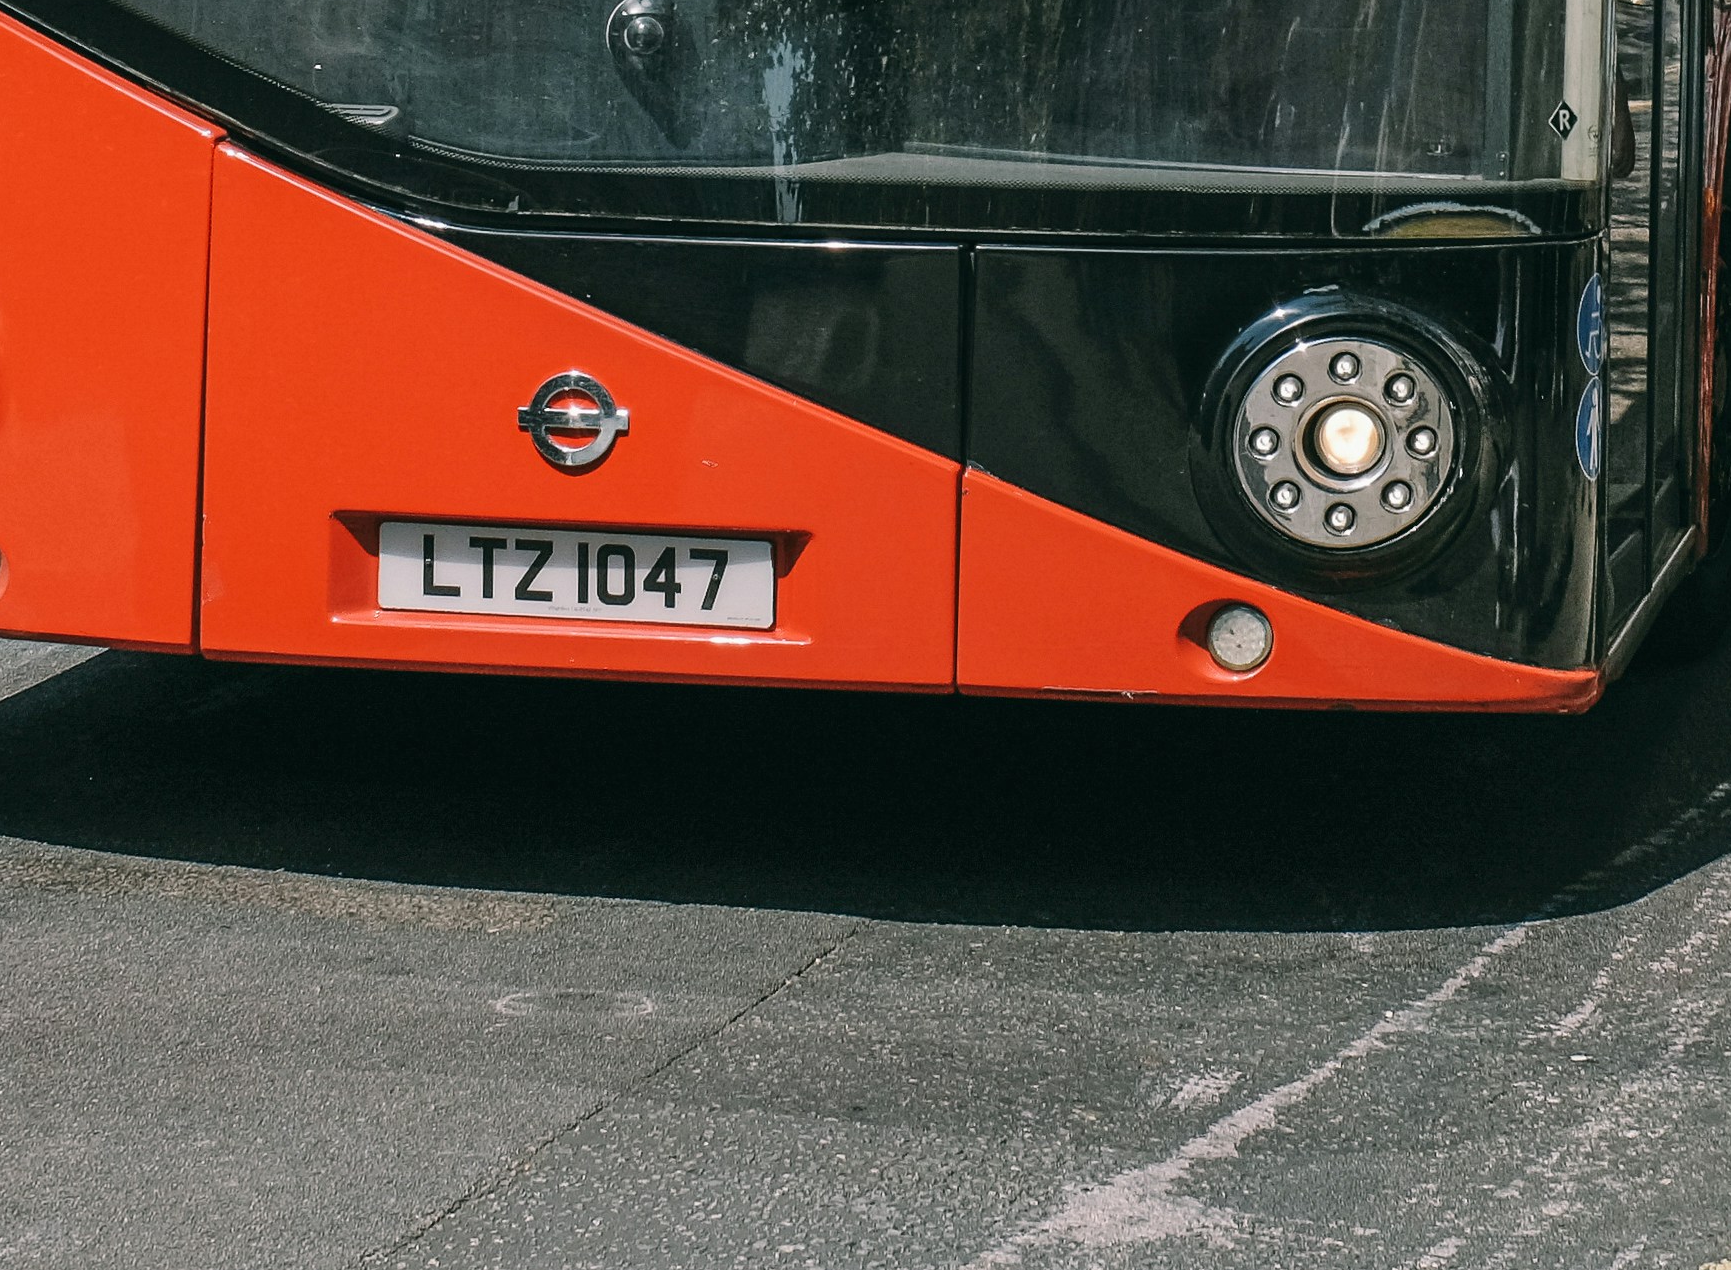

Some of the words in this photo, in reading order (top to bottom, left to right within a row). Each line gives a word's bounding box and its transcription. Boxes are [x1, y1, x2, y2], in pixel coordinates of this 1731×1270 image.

[1559, 109, 1571, 131] R
[423, 534, 554, 603] LTZ
[577, 541, 730, 612] 1047
